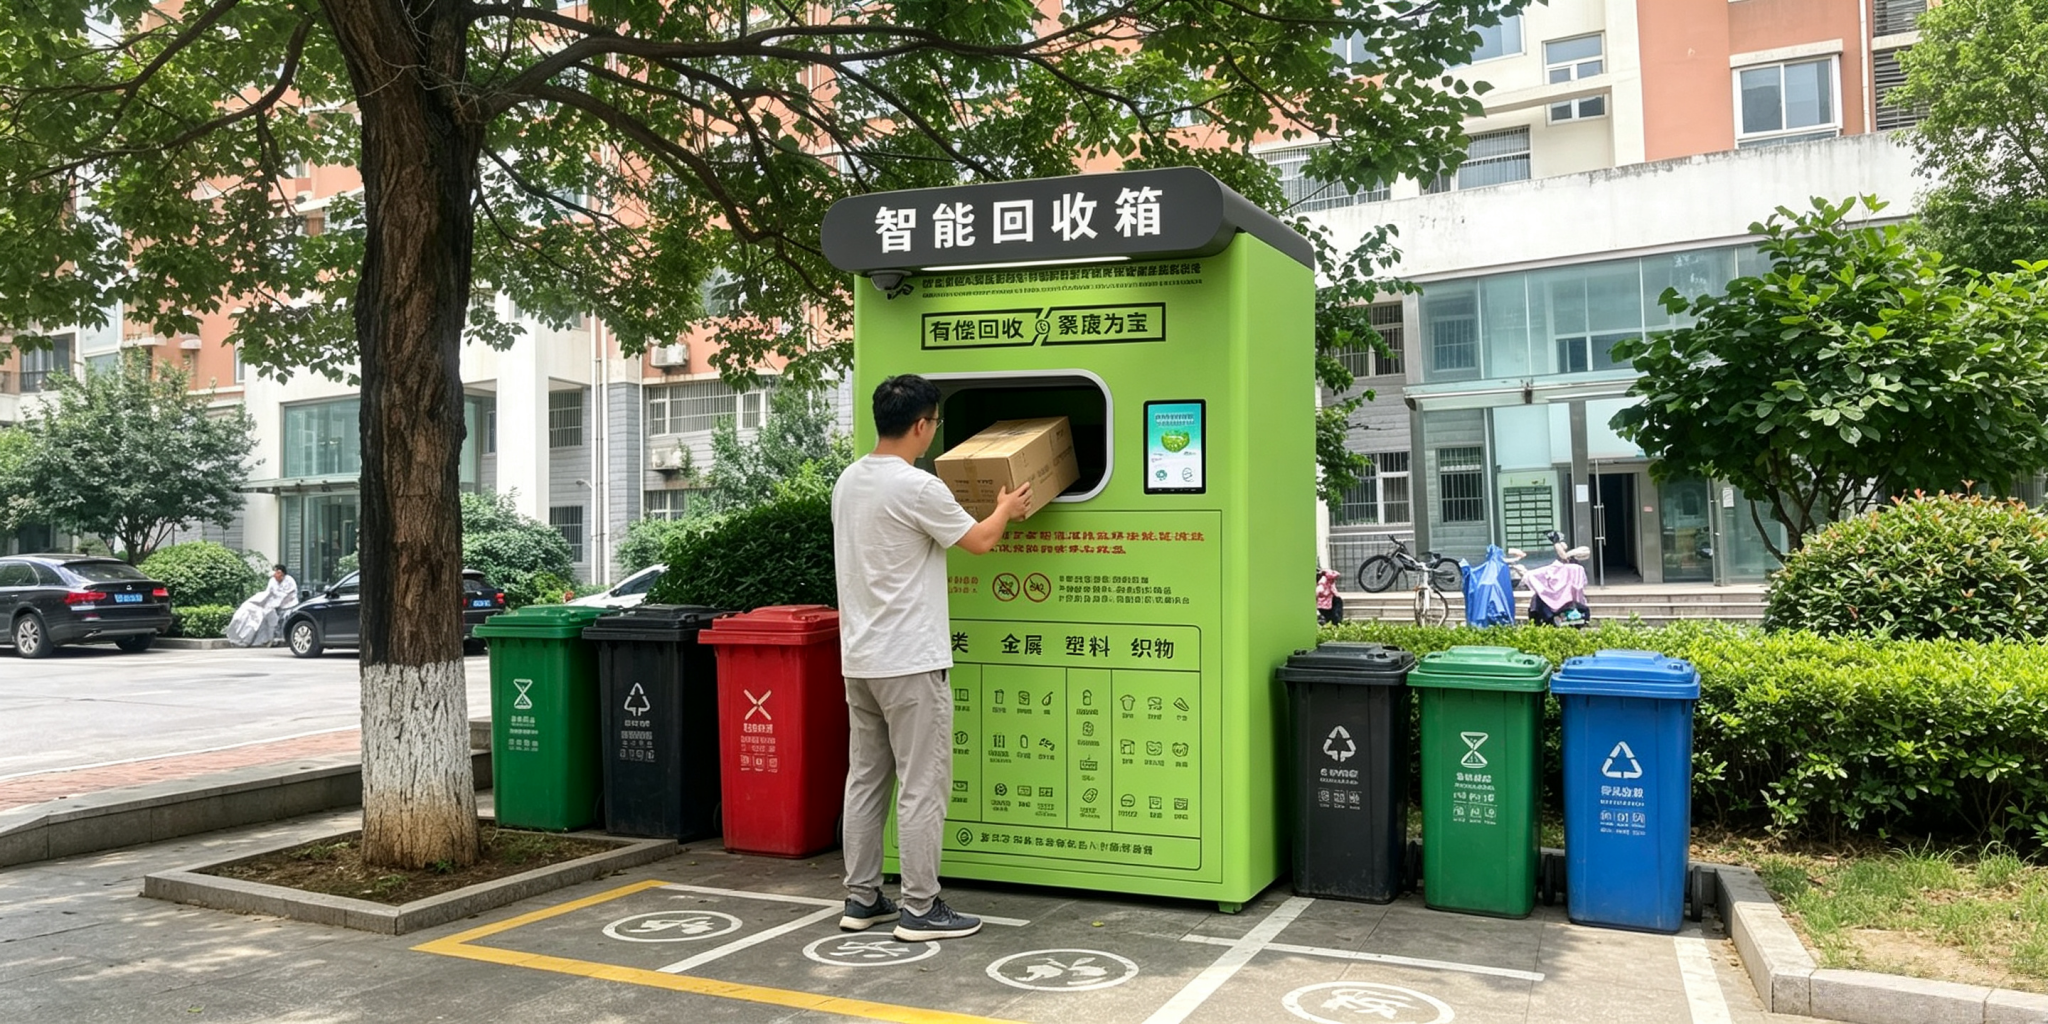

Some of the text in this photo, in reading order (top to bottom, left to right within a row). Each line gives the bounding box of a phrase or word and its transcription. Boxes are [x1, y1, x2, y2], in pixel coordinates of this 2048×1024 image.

[875, 185, 1164, 254] 智能回收箱
[1130, 637, 1175, 660] 织物
